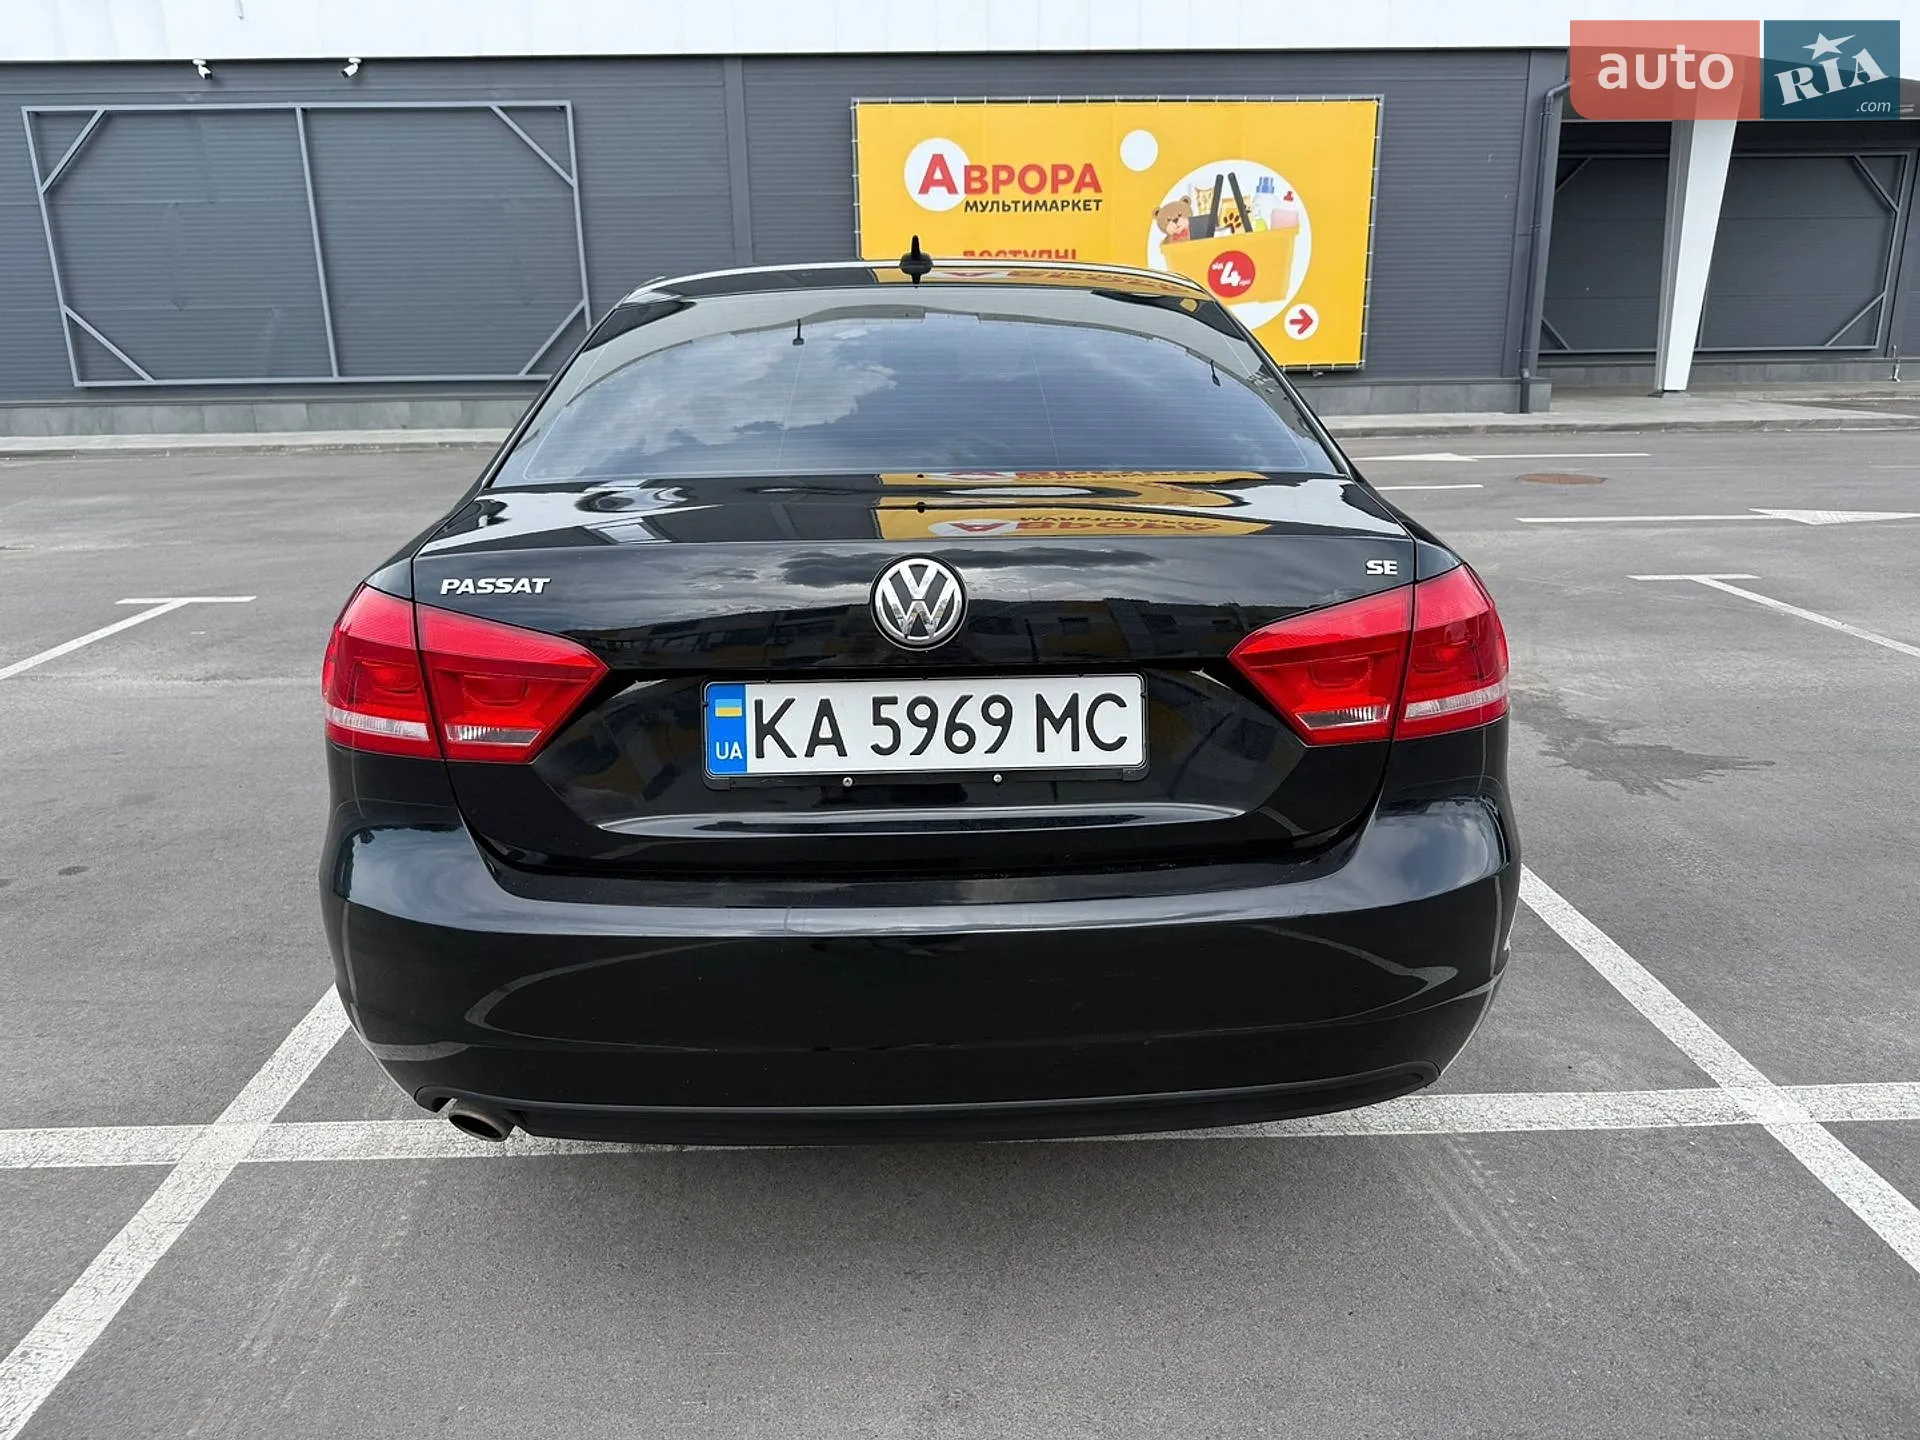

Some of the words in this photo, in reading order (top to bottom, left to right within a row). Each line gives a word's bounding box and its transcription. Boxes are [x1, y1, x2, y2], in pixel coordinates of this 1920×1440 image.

[918, 154, 1103, 195] АВРОРА
[964, 199, 1103, 213] МУЛЬТИМАРКЕТ
[1220, 261, 1241, 287] 4
[1366, 559, 1398, 575] SE
[440, 577, 551, 595] PASSAT
[754, 696, 849, 760] KA
[870, 692, 1014, 757] 5969
[1034, 691, 1129, 754] MC
[715, 741, 744, 760] UA
